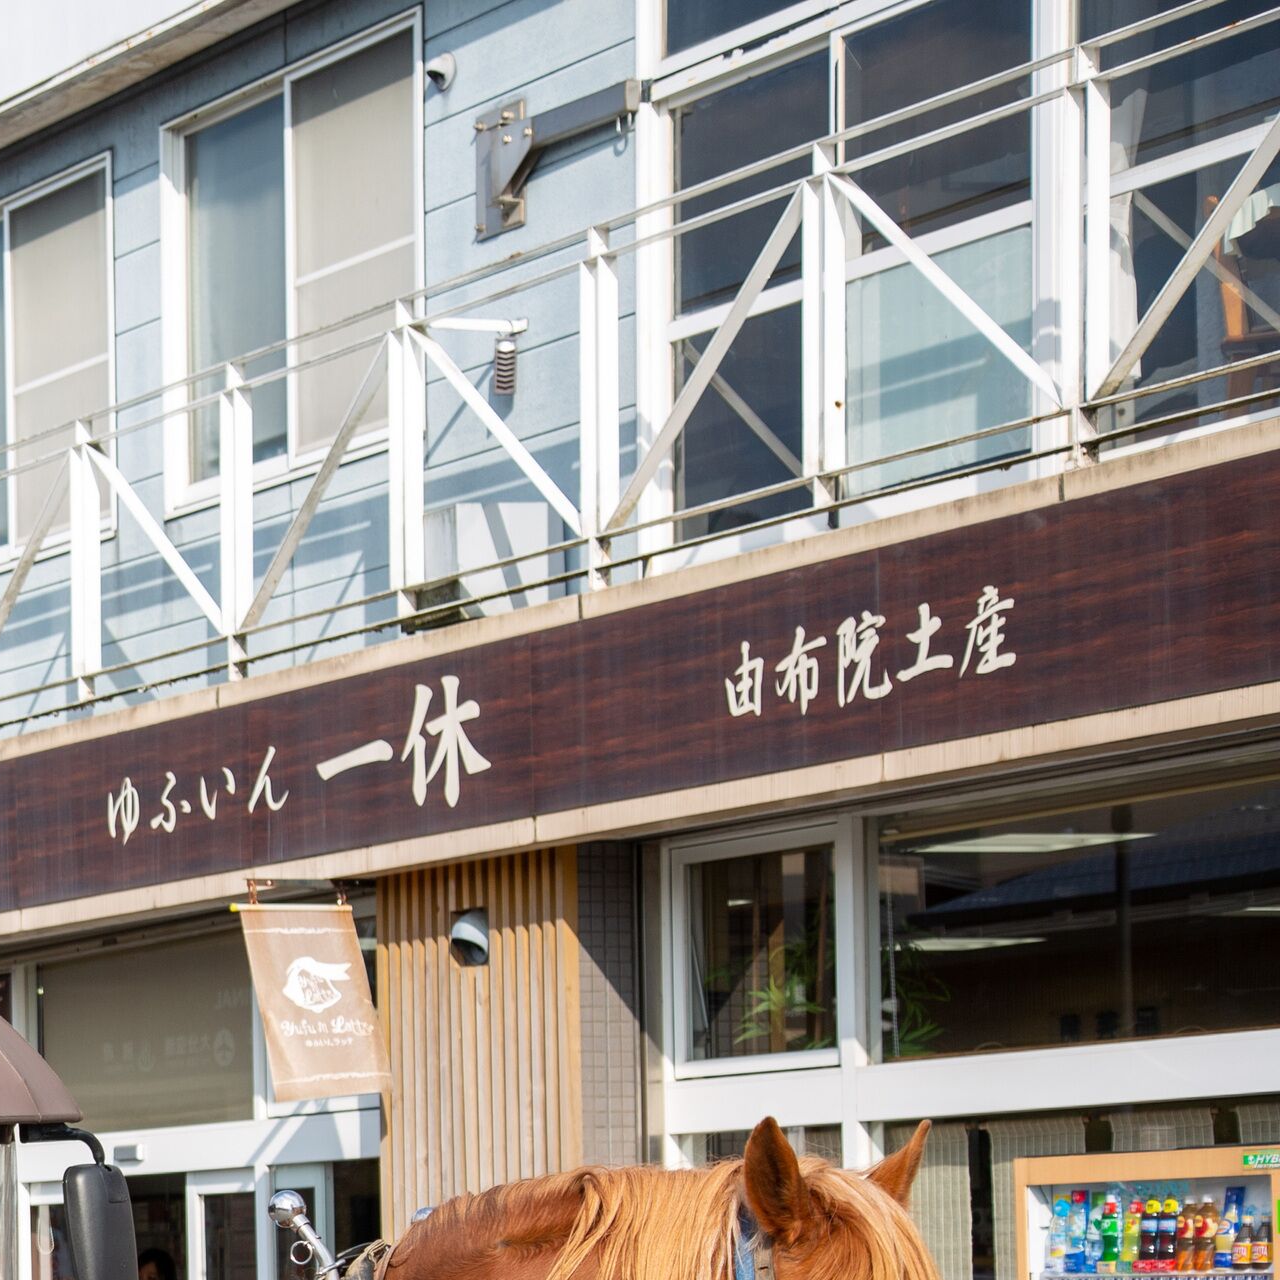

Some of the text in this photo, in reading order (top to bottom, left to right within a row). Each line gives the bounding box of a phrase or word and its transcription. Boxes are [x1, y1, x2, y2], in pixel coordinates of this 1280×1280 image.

[724, 585, 1017, 717] 由布院土産
[107, 674, 492, 846] ゆふいん 一休
[1255, 1154, 1280, 1166] HYB
